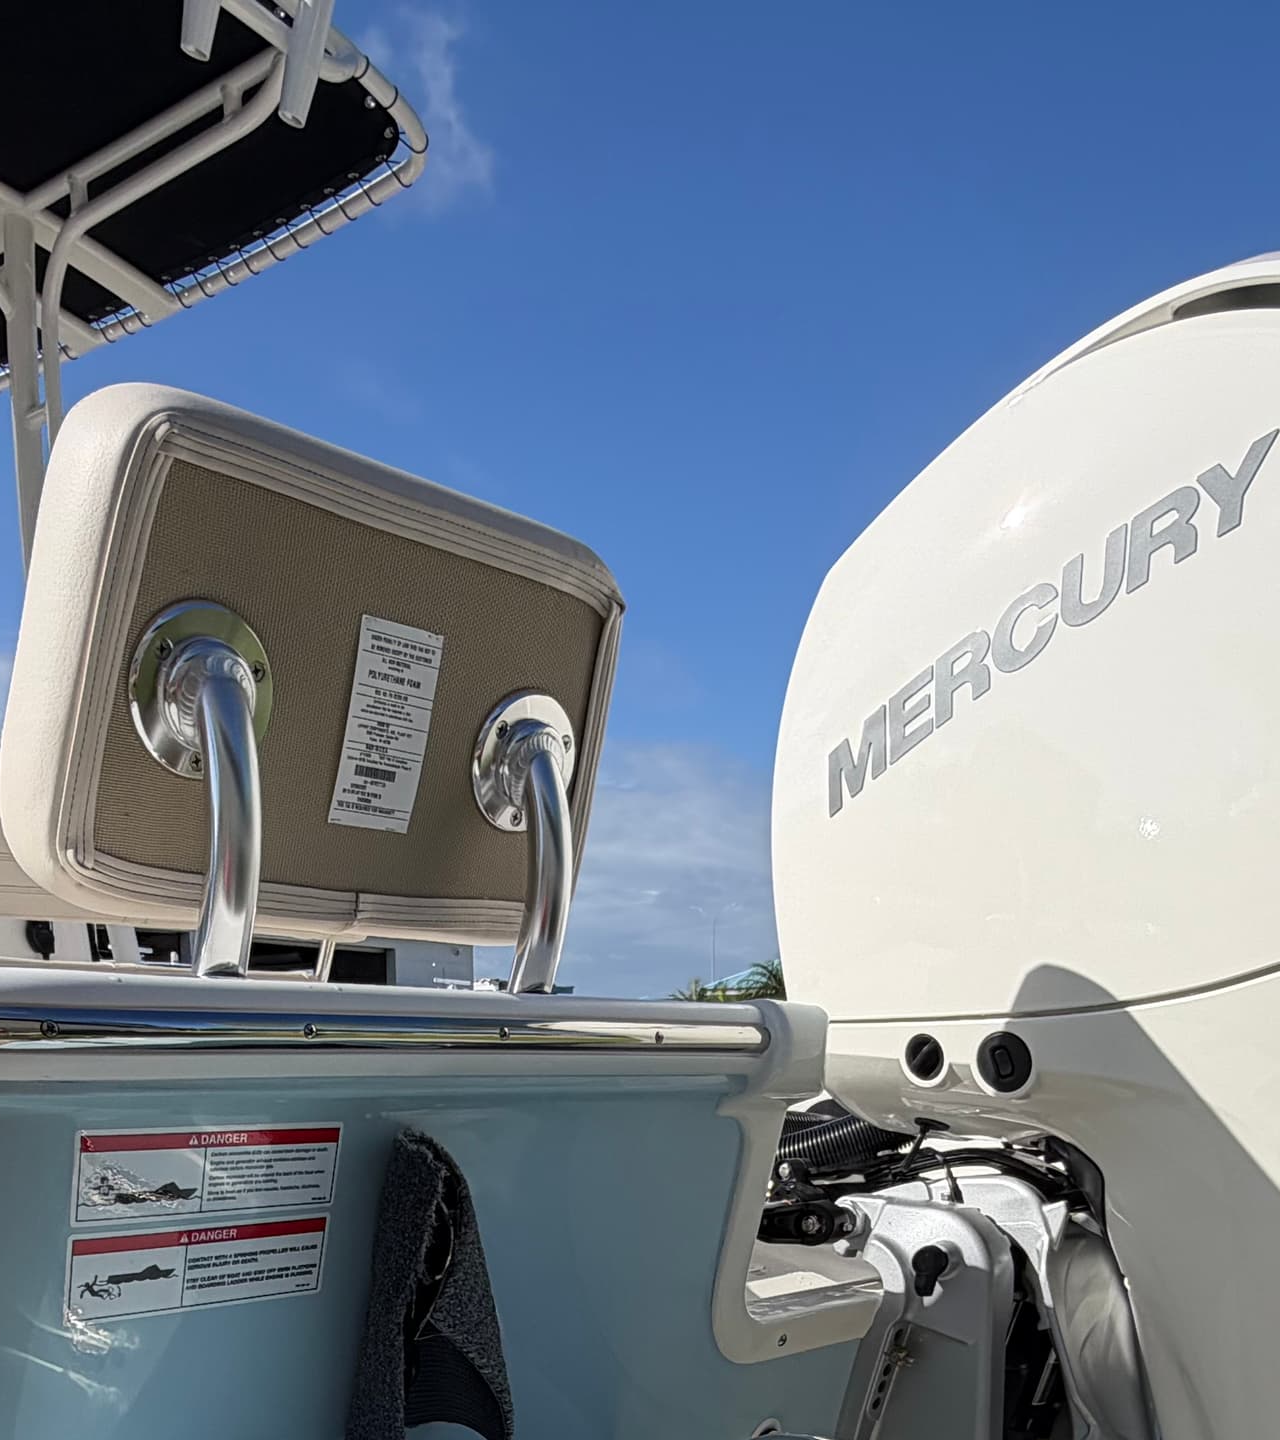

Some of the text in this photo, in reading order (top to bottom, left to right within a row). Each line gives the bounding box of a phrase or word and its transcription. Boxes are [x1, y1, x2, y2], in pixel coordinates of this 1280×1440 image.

[828, 428, 1280, 818] MERCURY
[201, 1132, 248, 1146] DANGER
[191, 1228, 238, 1242] DANGER
